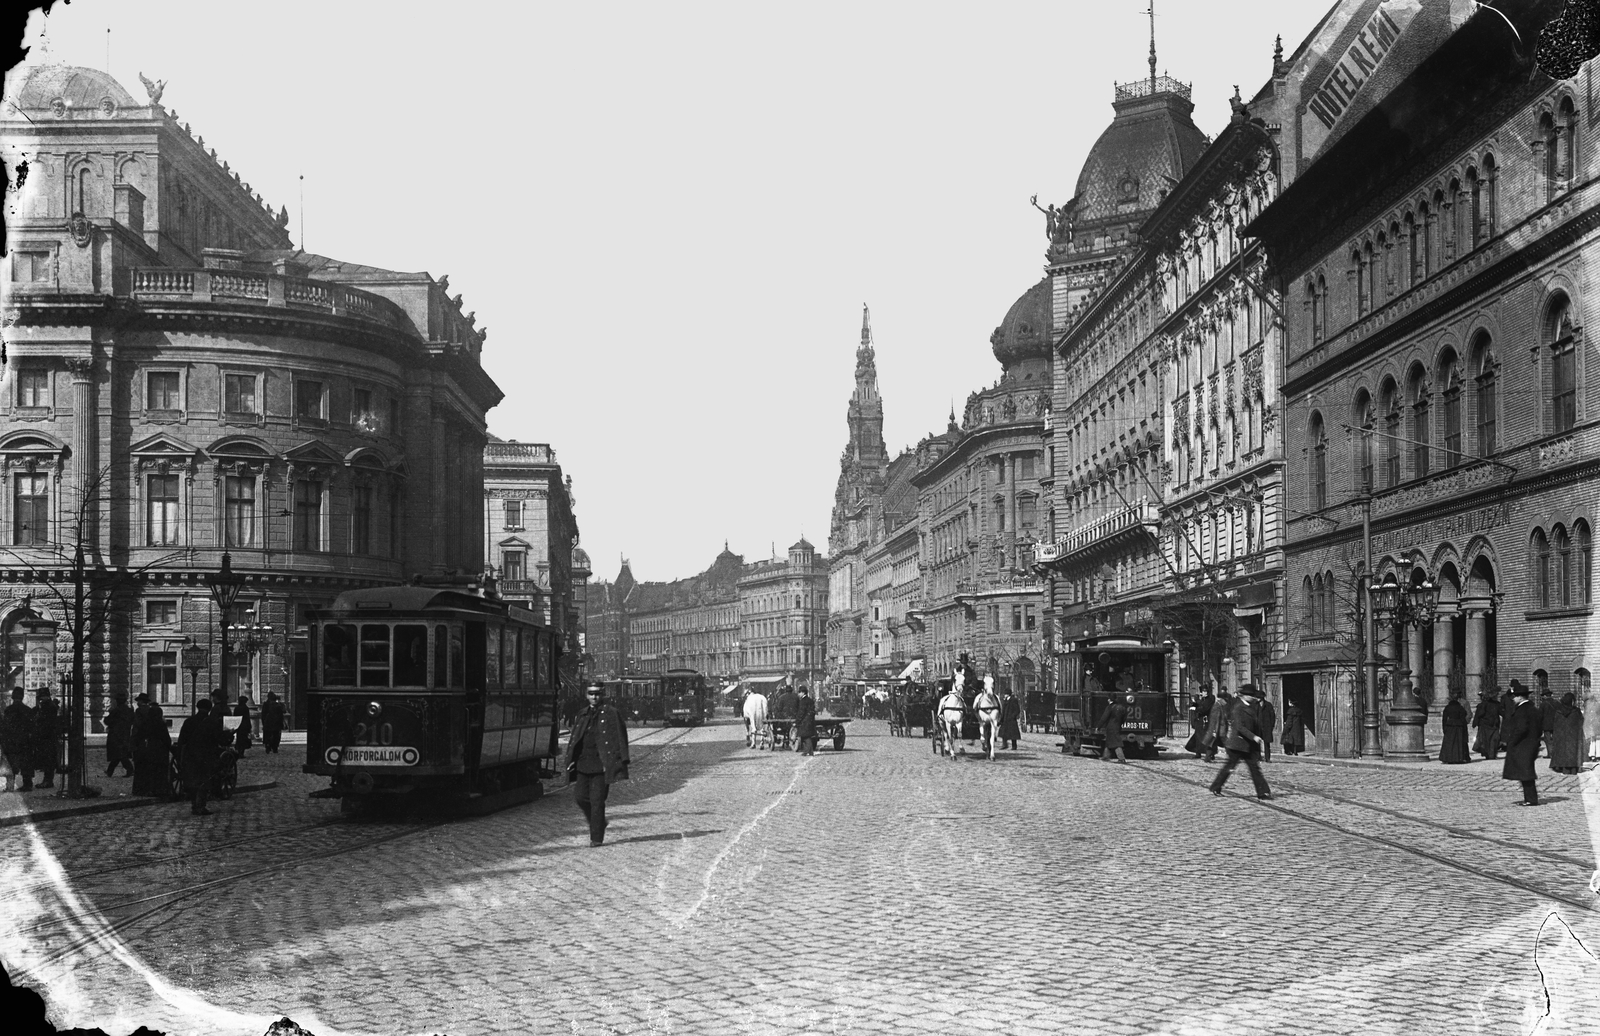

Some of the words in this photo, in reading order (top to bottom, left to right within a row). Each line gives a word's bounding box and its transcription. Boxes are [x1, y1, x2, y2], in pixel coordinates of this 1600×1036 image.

[1309, 61, 1364, 130] HOTEL
[1348, 9, 1401, 78] REMI
[1368, 521, 1433, 555] ECHNOLOGIAI
[356, 723, 393, 746] 210
